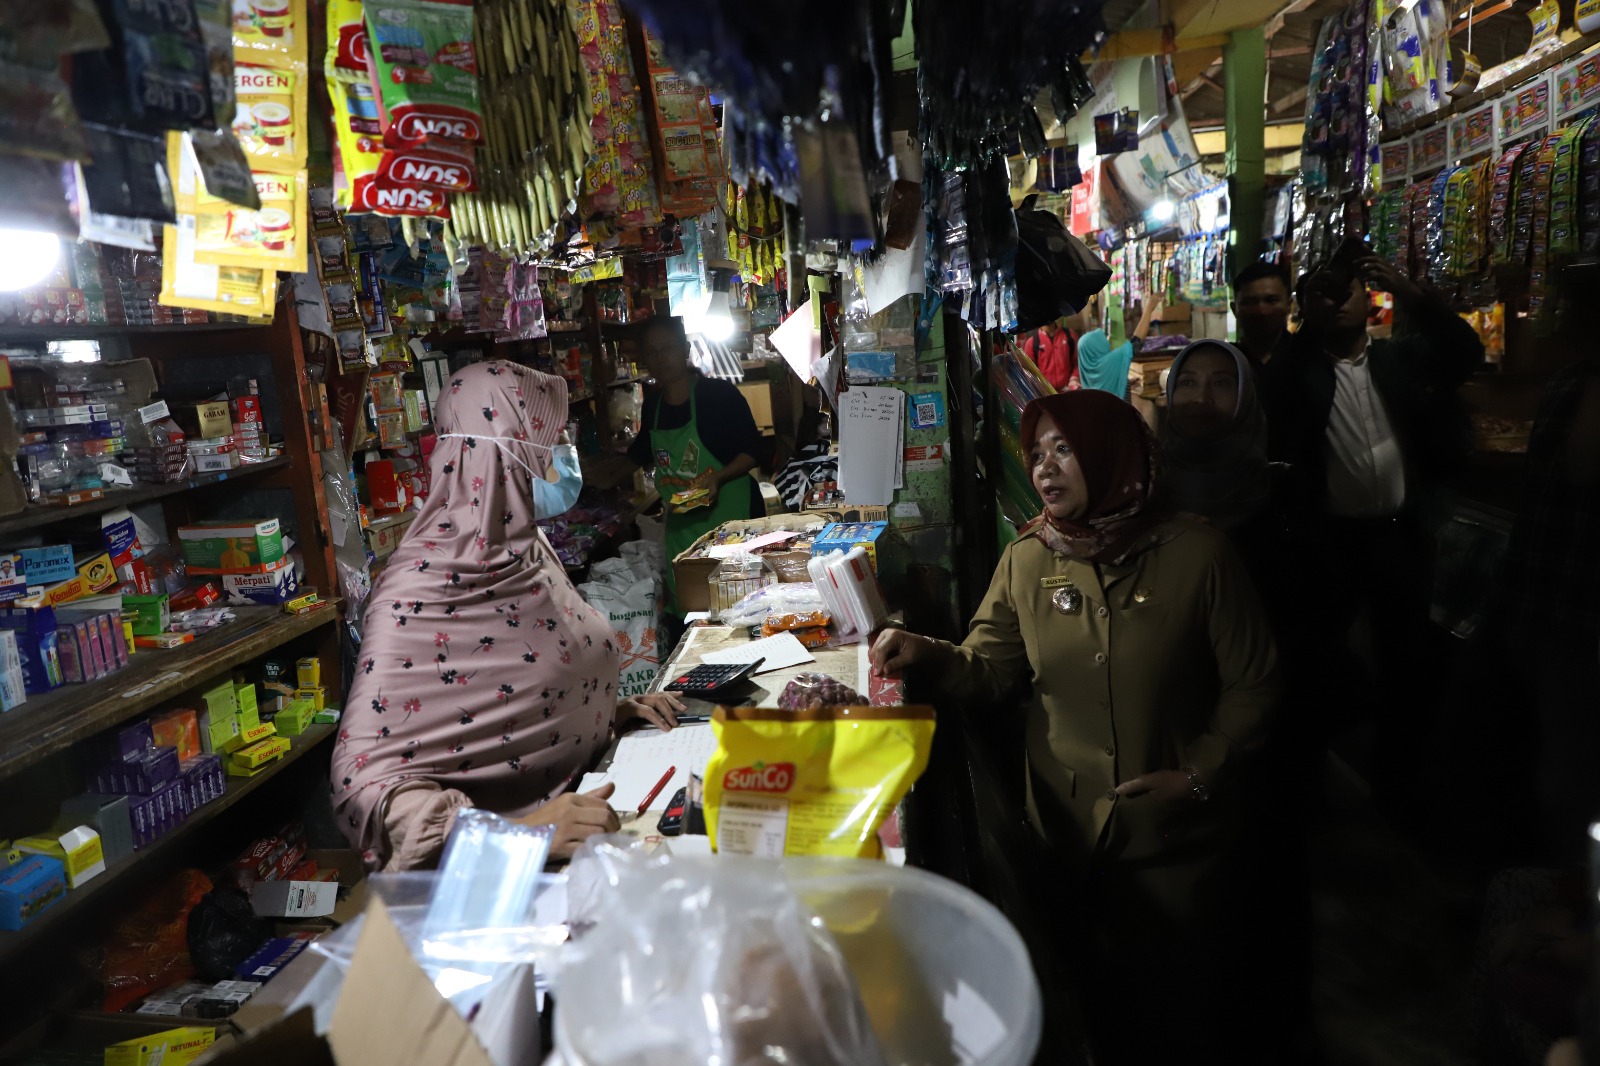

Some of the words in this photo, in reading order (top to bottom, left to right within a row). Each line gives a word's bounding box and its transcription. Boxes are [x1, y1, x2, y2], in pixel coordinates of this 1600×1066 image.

[233, 75, 289, 88] ERGEN
[411, 118, 468, 137] SUN
[402, 161, 460, 185] SUN
[377, 187, 433, 209] SUN
[203, 410, 226, 419] GARAM
[25, 556, 70, 571] Paramex
[234, 576, 270, 586] Merpati
[49, 581, 81, 605] Konidin
[609, 608, 654, 621] bogasari
[258, 745, 281, 761] ESEMAG
[727, 766, 789, 790] SunCo
